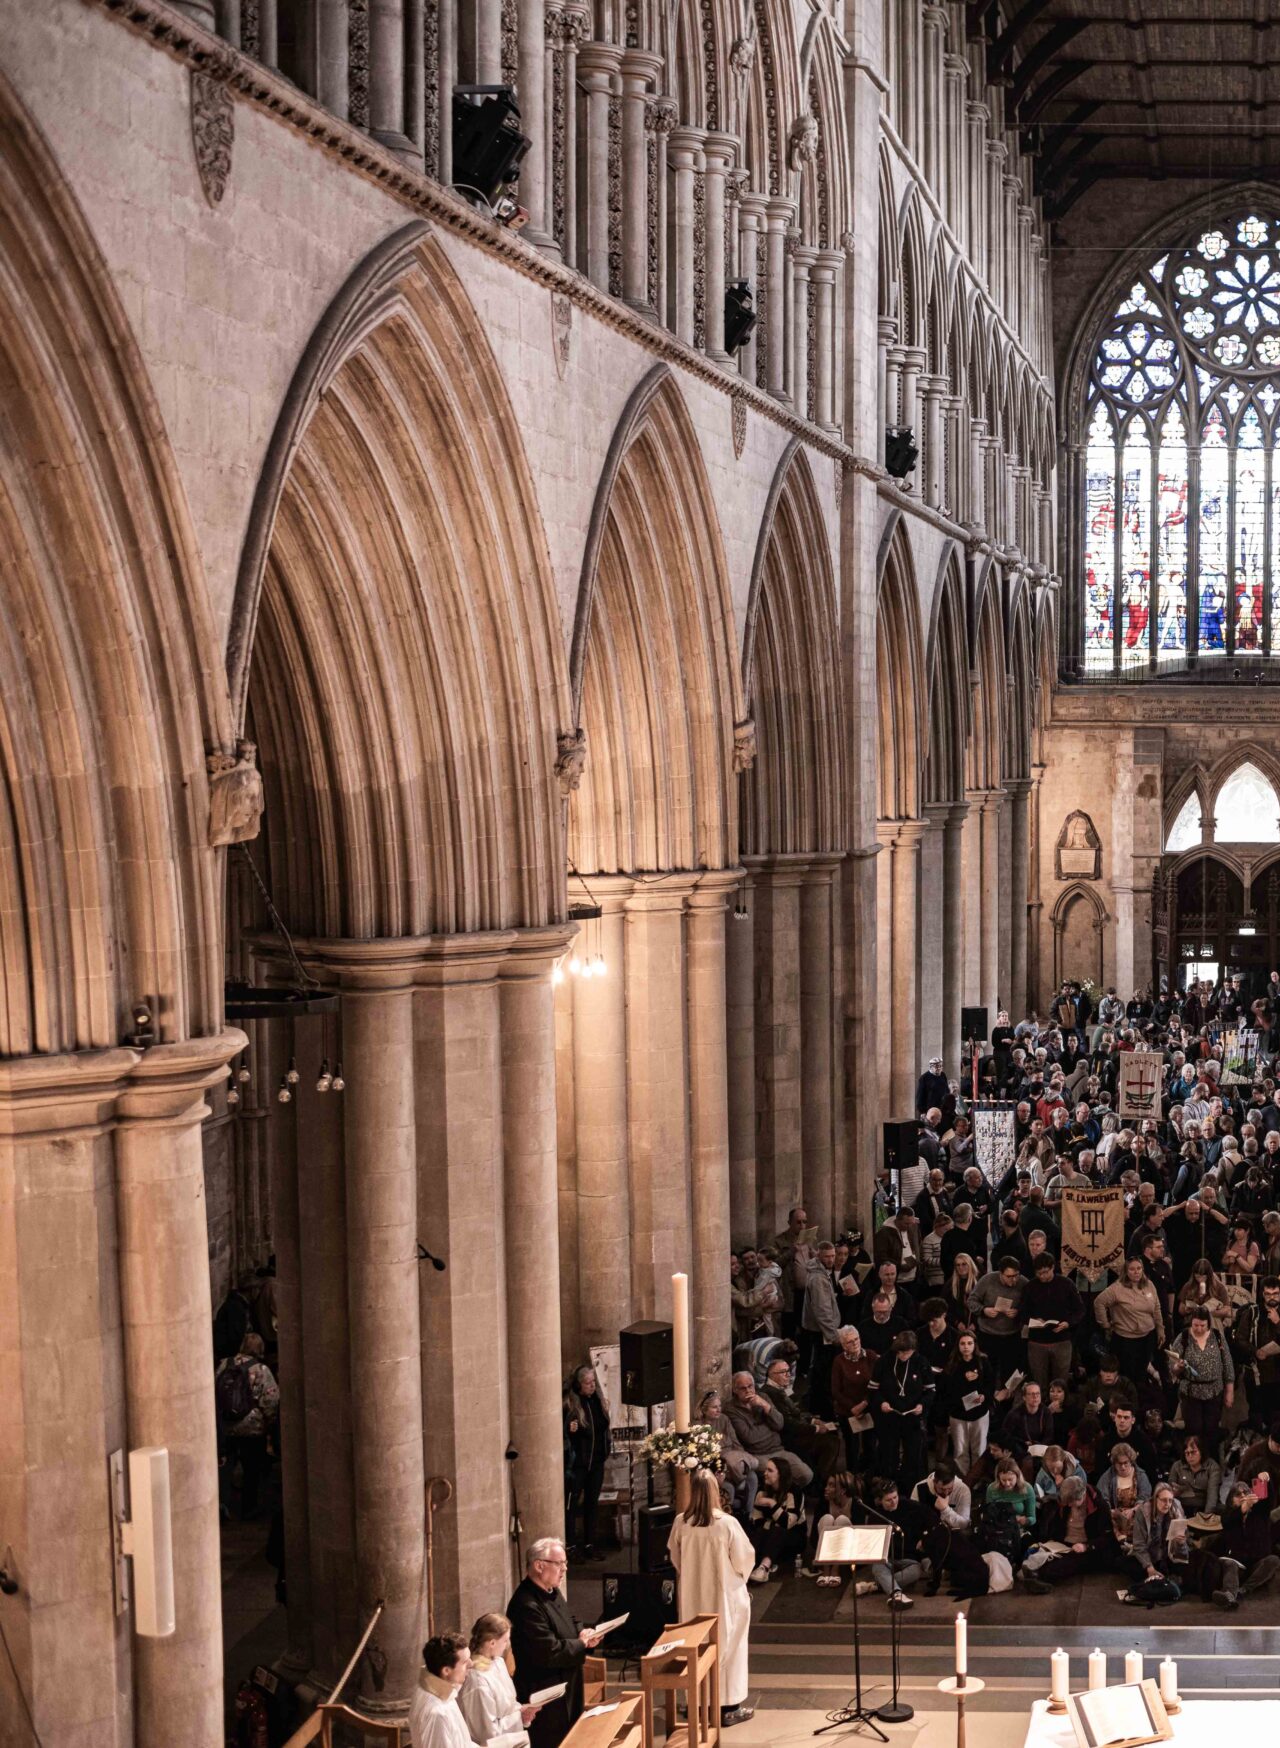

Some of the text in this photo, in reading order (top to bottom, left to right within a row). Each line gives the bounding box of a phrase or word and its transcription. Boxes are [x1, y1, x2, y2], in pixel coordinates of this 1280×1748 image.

[1125, 1059, 1158, 1069] RADLETT
[1076, 1192, 1119, 1204] LAWRENCE
[1094, 1242, 1124, 1268] LANGLEY
